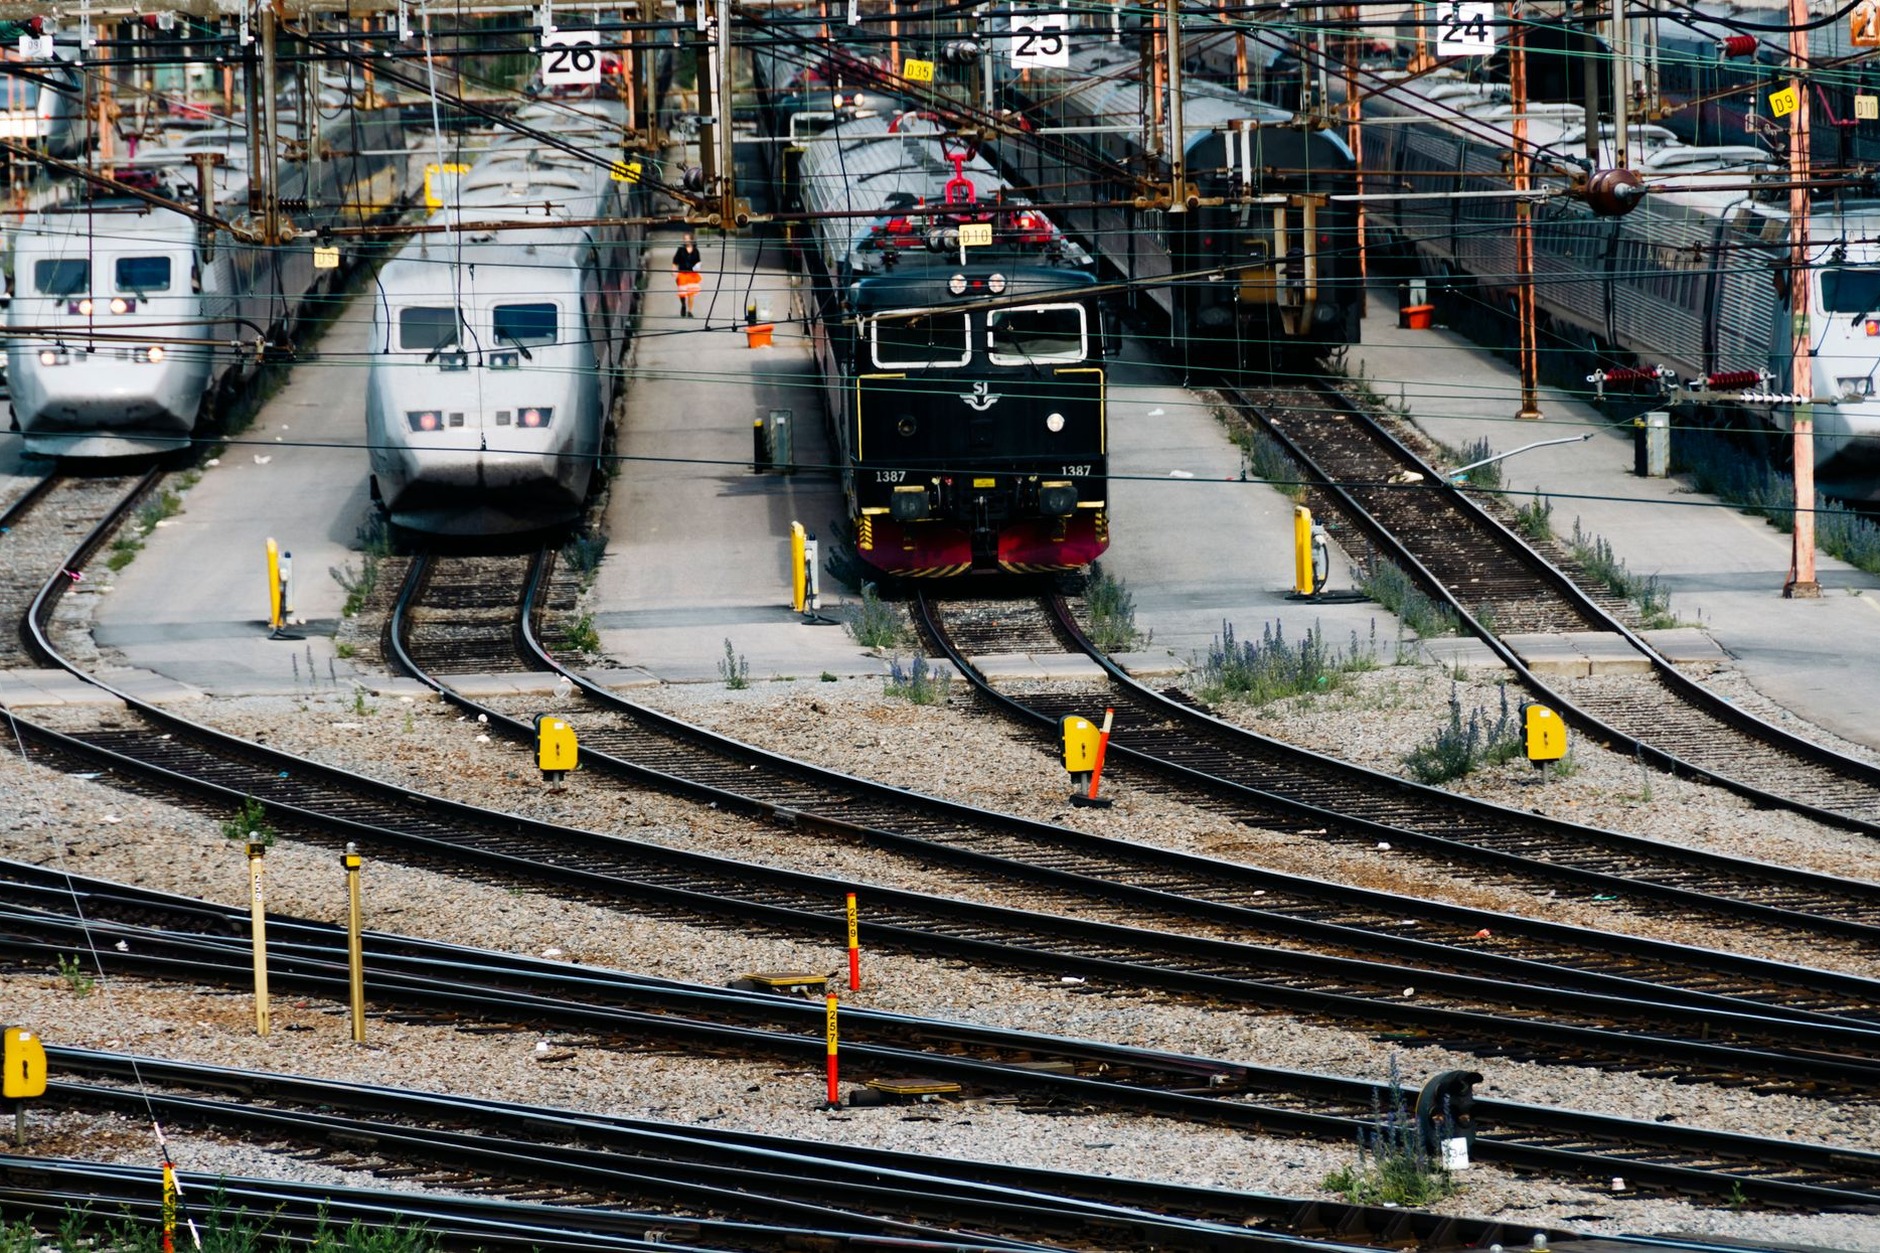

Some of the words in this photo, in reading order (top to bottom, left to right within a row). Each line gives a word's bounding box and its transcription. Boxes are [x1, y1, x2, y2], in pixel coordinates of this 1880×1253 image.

[1443, 13, 1488, 43] 24
[1016, 25, 1063, 56] 25
[548, 41, 595, 73] 26
[907, 64, 929, 78] D35
[1775, 94, 1794, 113] D9
[1858, 101, 1876, 116] D10
[963, 229, 988, 243] D10
[973, 381, 988, 395] SJ
[876, 471, 906, 482] 1387
[1061, 465, 1091, 477] 1387
